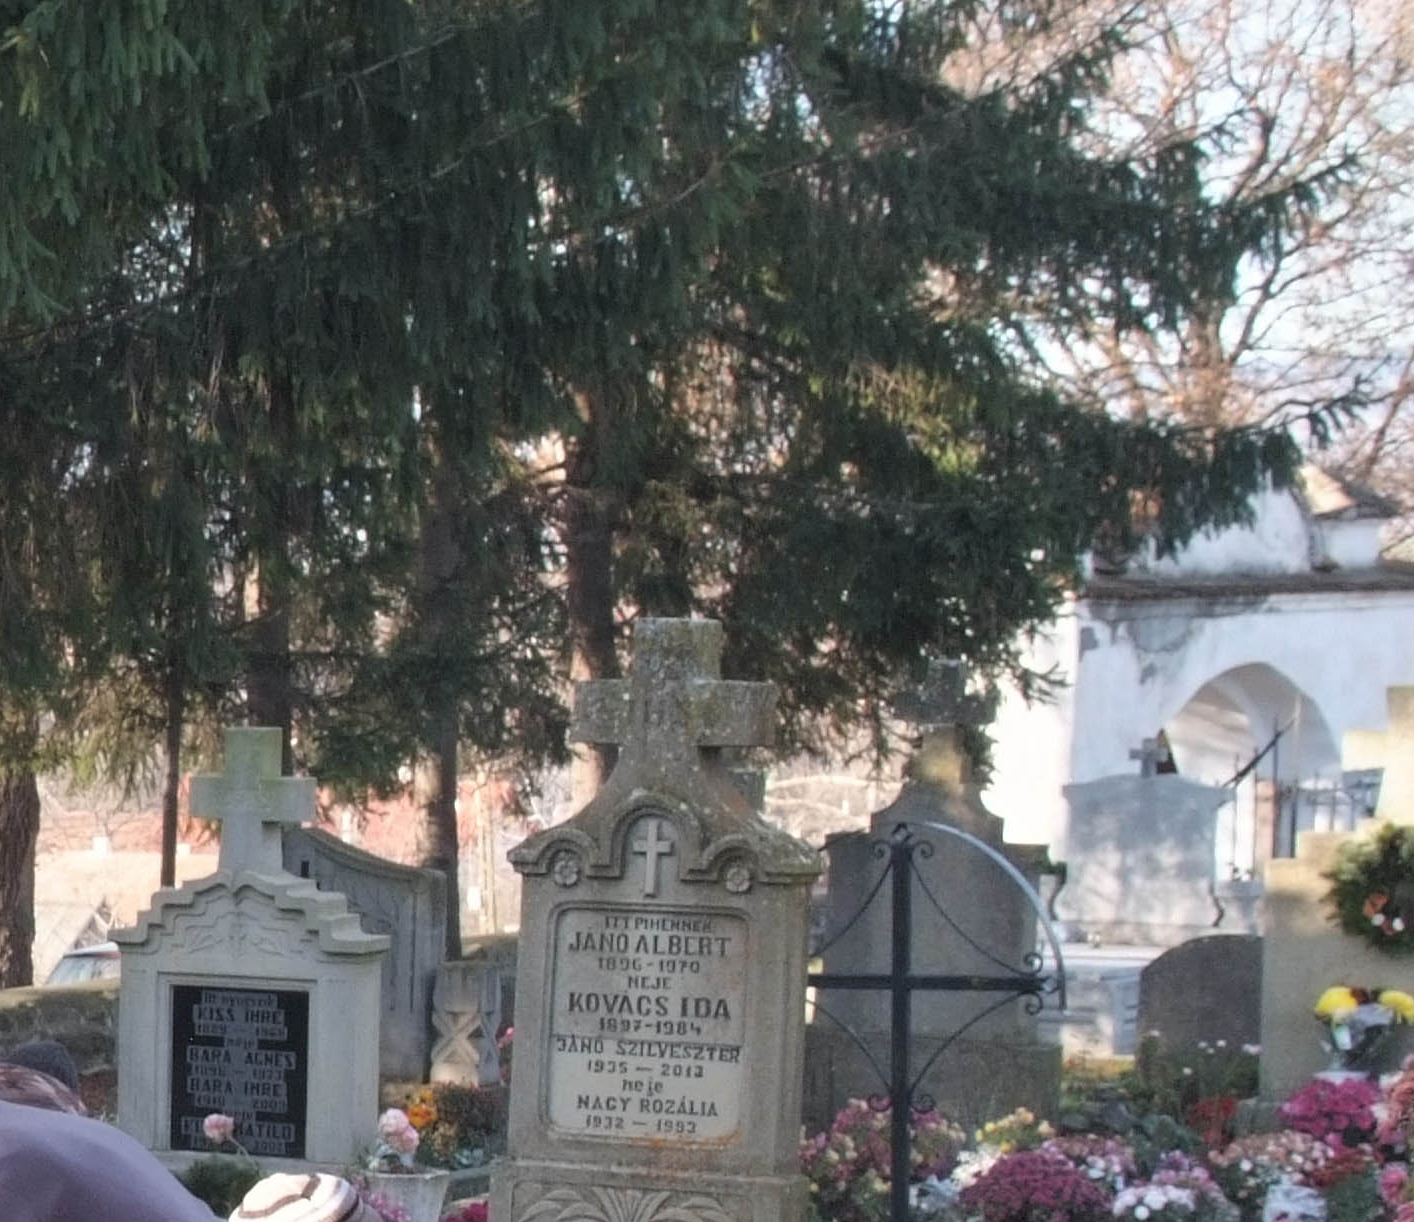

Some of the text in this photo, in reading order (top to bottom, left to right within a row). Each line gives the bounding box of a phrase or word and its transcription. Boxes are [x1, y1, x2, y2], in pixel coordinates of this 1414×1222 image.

[635, 934, 733, 957] ALBERT
[568, 989, 732, 1021] KOVÁCS IDA
[615, 1039, 741, 1064] SZILVESZTER
[576, 1095, 718, 1117] NAGY ROZÁLIA
